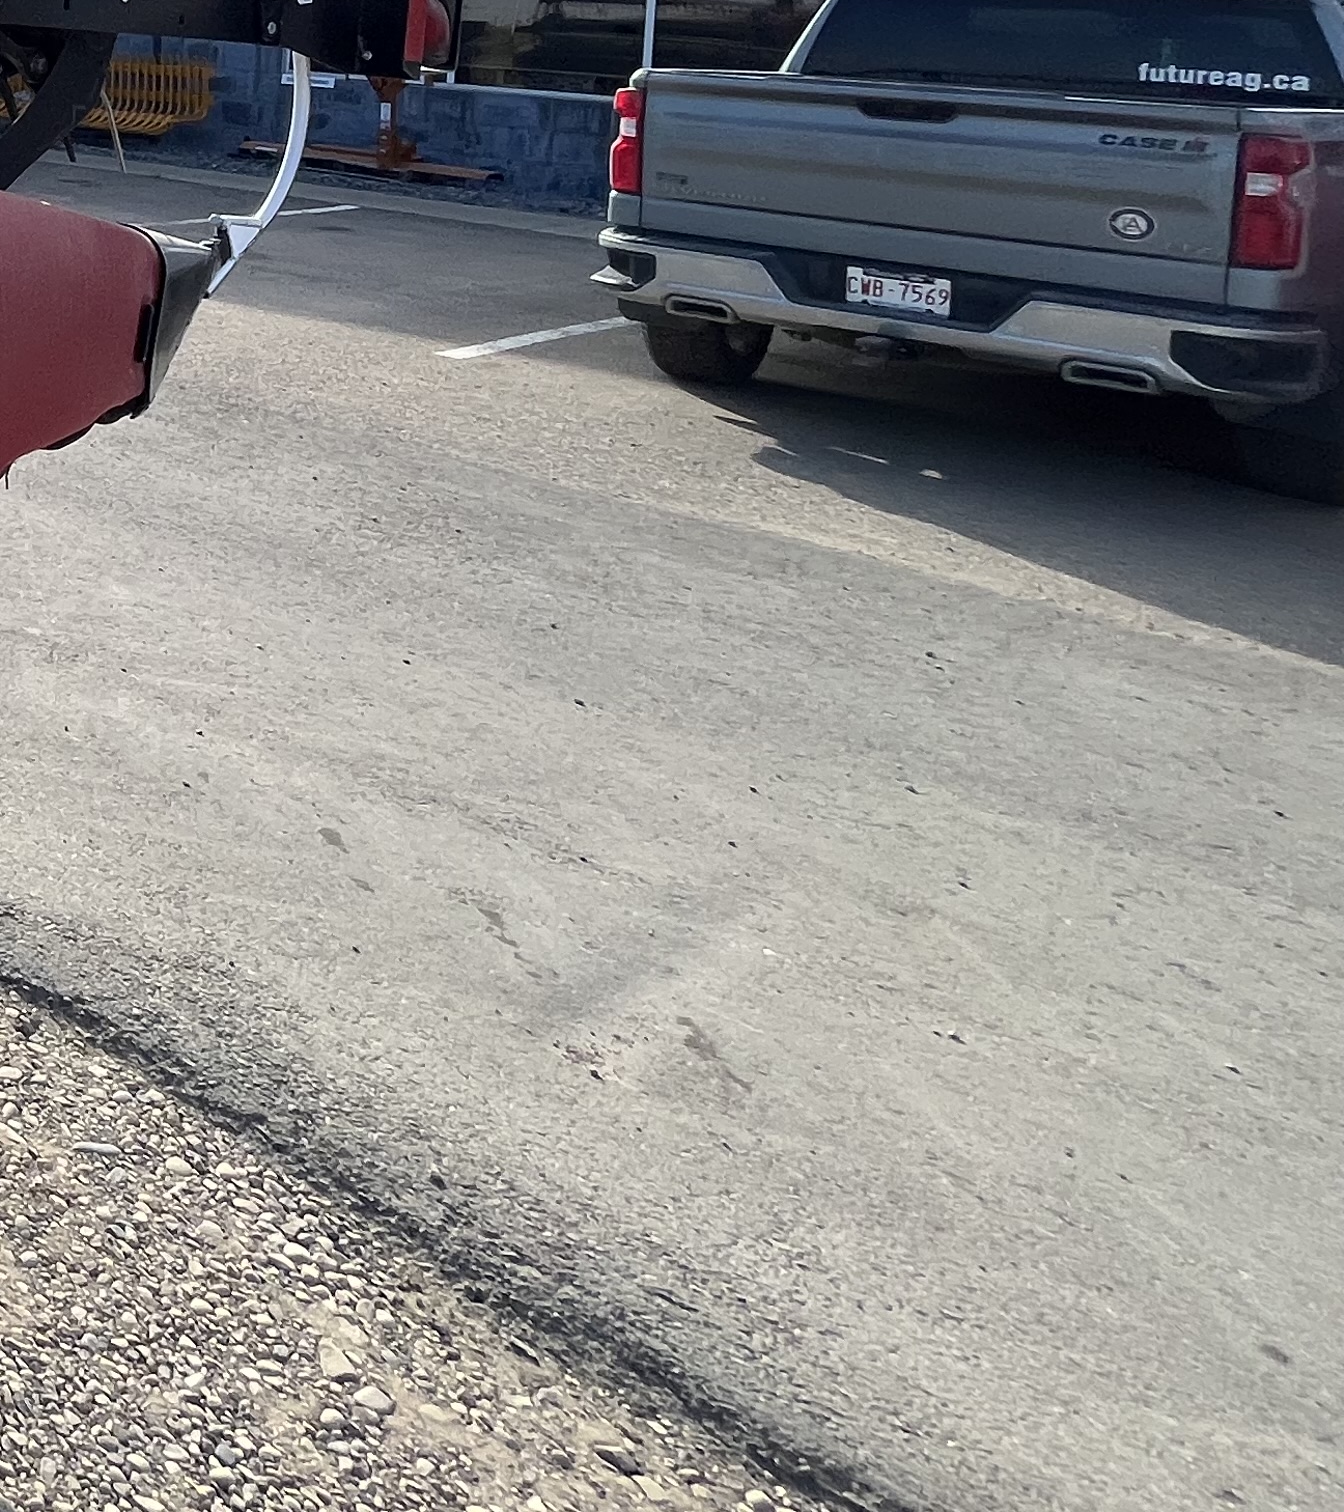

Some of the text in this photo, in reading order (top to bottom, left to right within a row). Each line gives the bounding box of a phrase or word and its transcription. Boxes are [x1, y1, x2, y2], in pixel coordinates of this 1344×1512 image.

[1138, 62, 1310, 92] futureag.ca
[1099, 133, 1178, 151] CASE
[848, 276, 950, 306] CWB-7569
